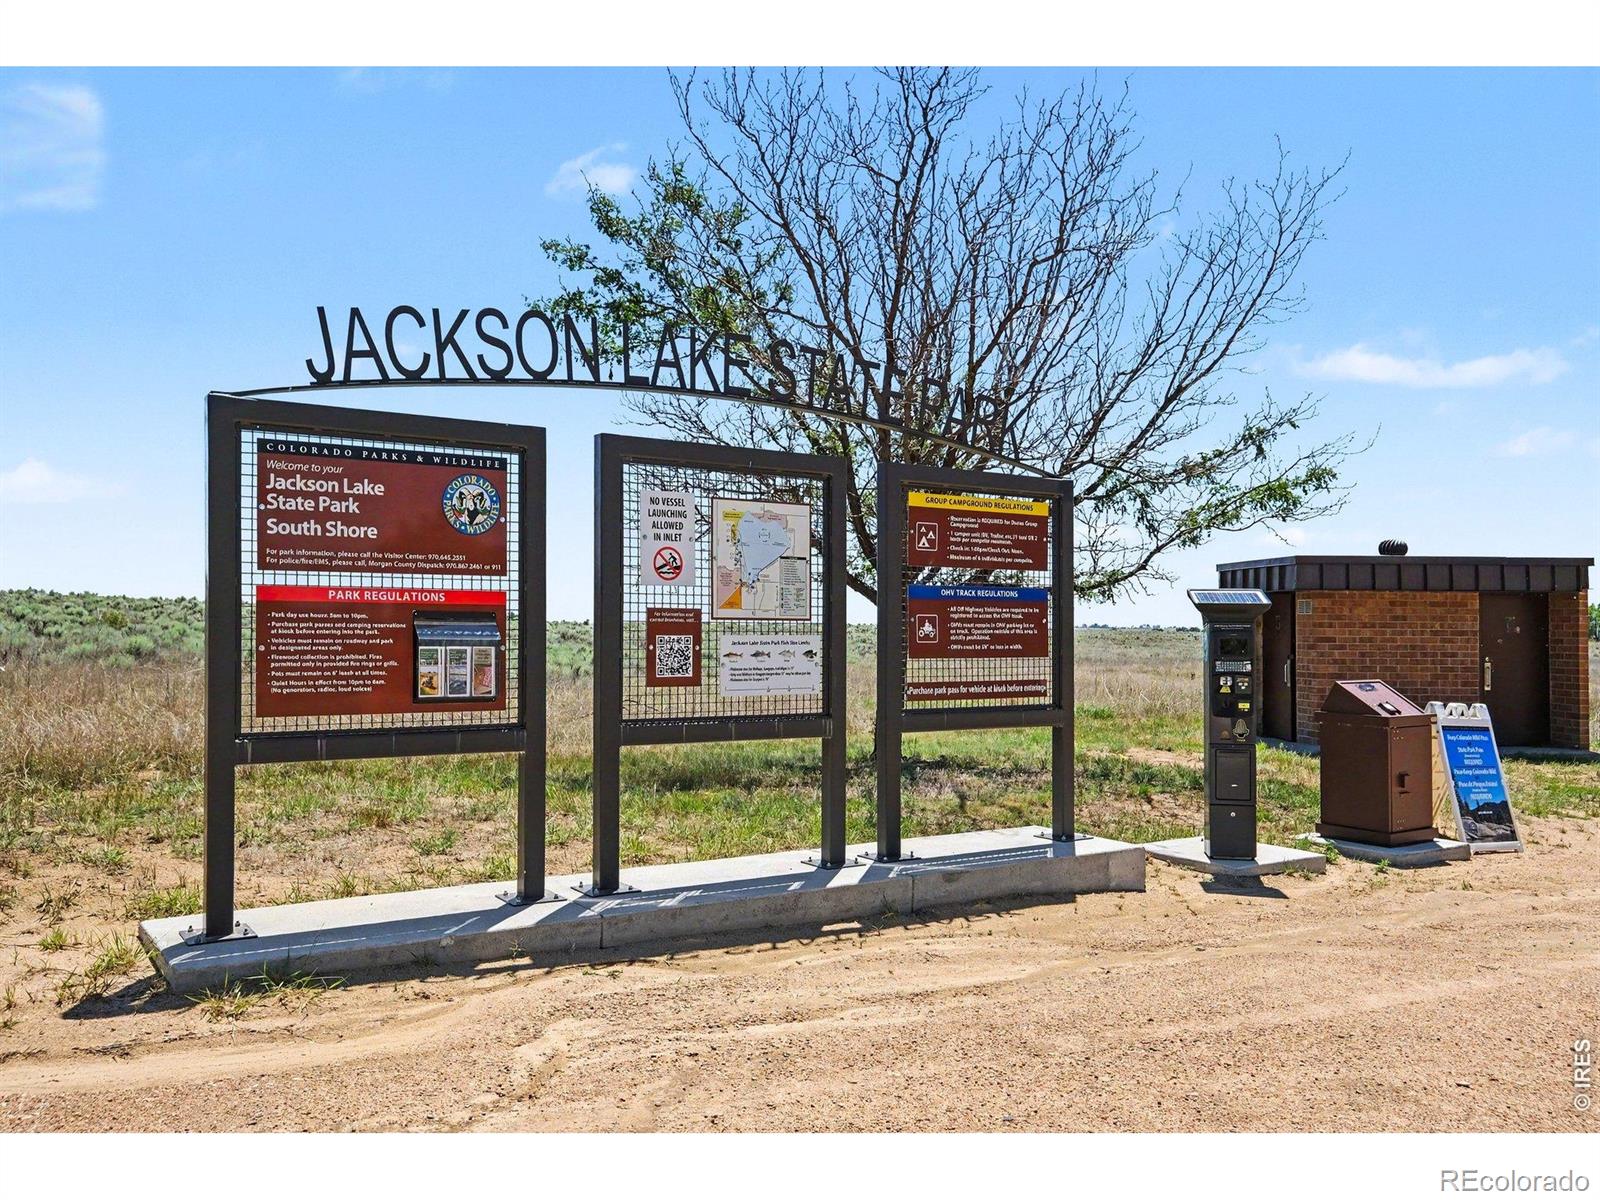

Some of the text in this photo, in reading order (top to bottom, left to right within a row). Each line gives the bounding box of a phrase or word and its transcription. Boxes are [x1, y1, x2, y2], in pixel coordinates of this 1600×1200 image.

[305, 305, 600, 383] JACKSON
[623, 320, 751, 394] LAKE
[768, 338, 906, 425] STATE
[266, 443, 500, 468] COLORADO PARKS & WILDLIFE
[266, 460, 344, 475] Welcome to your
[266, 473, 385, 496] Jackson Lake
[266, 493, 360, 514] State Park
[443, 475, 499, 534] COLORADO PARKS WILDLIFE
[650, 496, 686, 507] NO VESSEL
[925, 496, 1034, 512] GROUP CAMPGROUND REGULATIONS
[648, 509, 688, 519] LAUNCHING
[266, 518, 378, 539] South Shore
[652, 521, 684, 530] ALLOWED
[653, 533, 682, 542] IN INLET
[368, 560, 392, 568] Morgan
[328, 590, 446, 602] PARK REGULATIONS
[956, 589, 977, 597] TRACK
[977, 590, 1019, 598] REGULATIONS
[285, 611, 298, 620] day
[909, 686, 933, 695] Purchase
[934, 686, 947, 696] park
[947, 687, 960, 696] pass
[960, 685, 968, 693] for
[969, 685, 987, 693] vehicle
[1007, 684, 1023, 693] before
